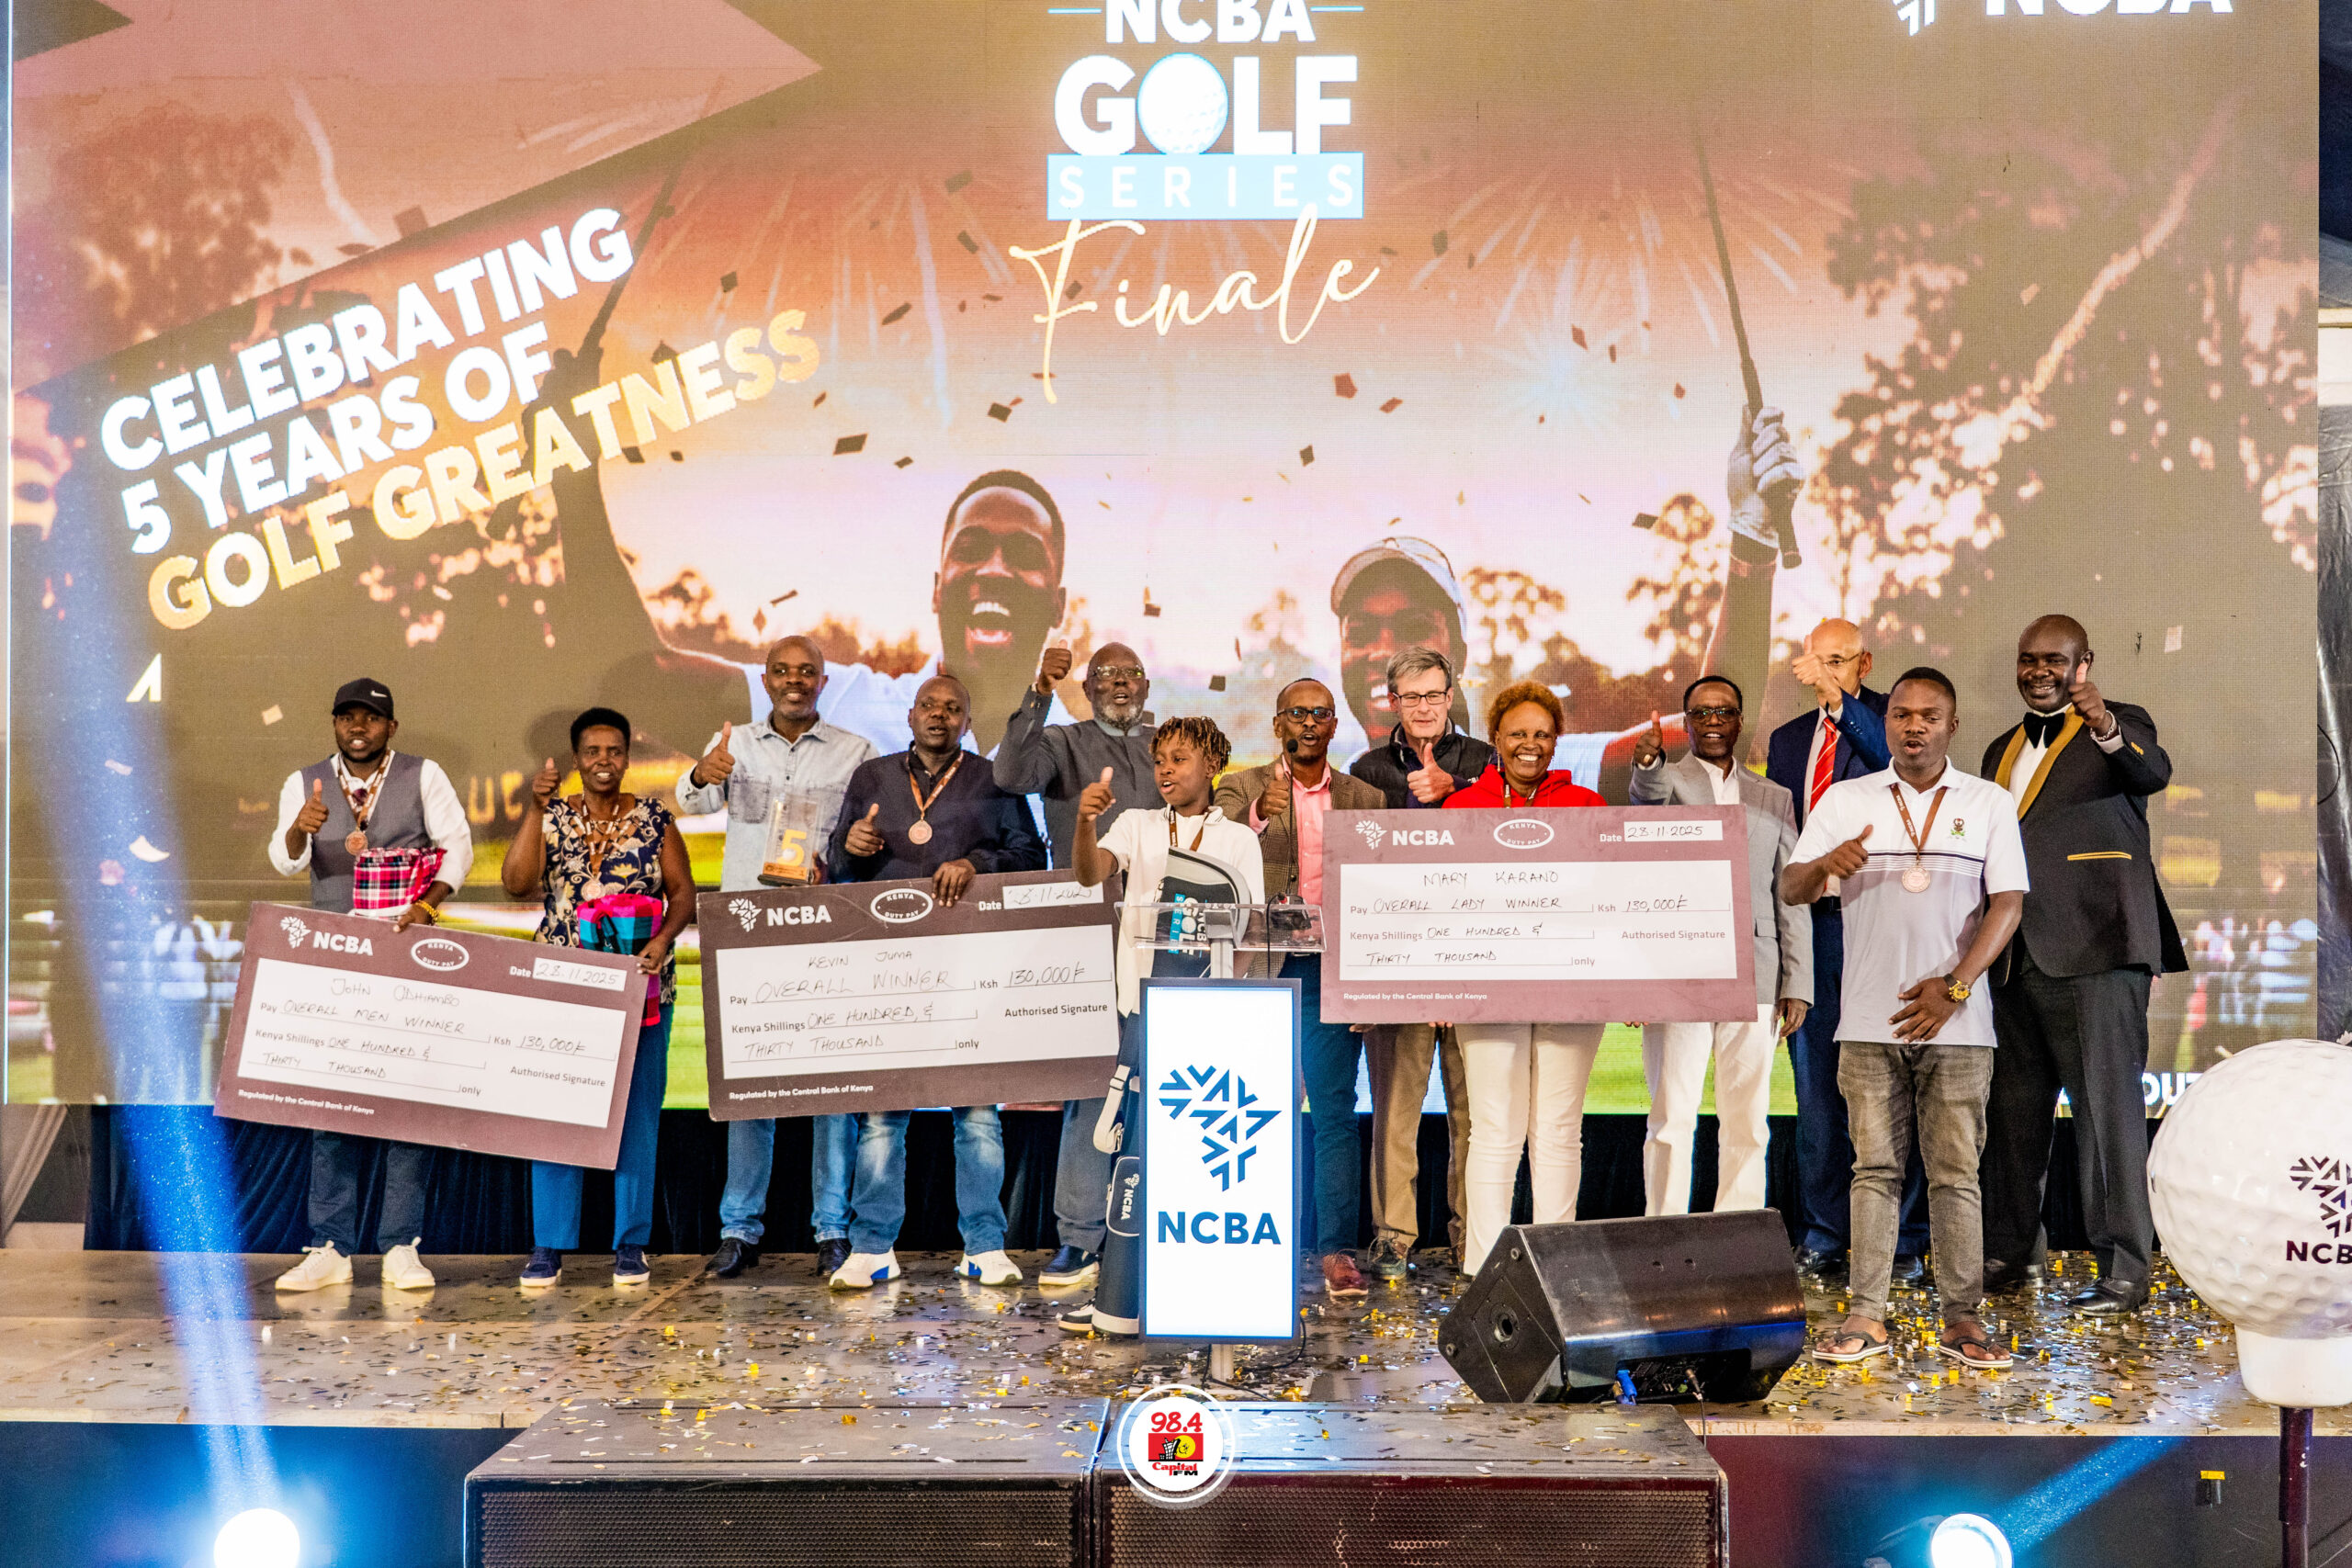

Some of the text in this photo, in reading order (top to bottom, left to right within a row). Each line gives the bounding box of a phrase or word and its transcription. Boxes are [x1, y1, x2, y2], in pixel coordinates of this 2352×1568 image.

[1106, 0, 1317, 43] NCBA
[1054, 52, 1358, 155] GOLF
[1058, 164, 1353, 208] SERIES
[1009, 203, 1380, 404] Finale
[100, 208, 636, 472] CELEBRATING
[120, 321, 552, 555] 5 YEARS OF
[147, 307, 822, 631] GOLF GREATNESS
[1392, 829, 1455, 846] NCBA
[1600, 833, 1623, 842] Date
[1424, 872, 1467, 888] MARY
[887, 893, 914, 901] KENYA
[978, 900, 1001, 911] Date
[1373, 897, 1562, 913] OVERALL LADY WINNER
[766, 904, 832, 927] NCBA
[1351, 906, 1367, 916] Pay
[1598, 903, 1616, 912] Ksh
[1196, 912, 1207, 947] NCB
[1350, 931, 1423, 942] Kenya Shillings
[1427, 927, 1451, 939] ONE
[1465, 926, 1521, 938] HUNDRED
[1622, 930, 1725, 941] Authorised Signature
[313, 931, 374, 956] NCBA
[808, 951, 912, 969] KEVIN JUMA
[1366, 950, 1498, 966] THIRTY THOUSAND
[1574, 956, 1595, 967] only
[509, 965, 532, 978] Date
[755, 969, 954, 1003] OVERALL WINNER
[979, 979, 998, 989] Ksh
[393, 984, 460, 1008] ODHIAMBO
[730, 995, 748, 1006] Pay
[1343, 992, 1487, 1001] Regulated by the Central Bank of Kenya
[260, 1001, 277, 1014] Pay
[1004, 1003, 1108, 1018] Authorised Signature
[284, 999, 465, 1034] OVERALL MEN WINNER
[808, 1012, 836, 1028] ONE
[732, 1021, 806, 1034] Kenya Shillings
[255, 1029, 324, 1047] Kenya Shillings
[494, 1036, 512, 1047] Ksh
[958, 1039, 979, 1050] only
[328, 1037, 351, 1049] ONE
[361, 1040, 416, 1057] HUNDRED
[744, 1034, 885, 1060] THIRTY THOUSAND
[263, 1052, 388, 1079] THIRTY THOUSAND
[510, 1065, 606, 1088] Authorised Signature
[461, 1084, 481, 1097] only
[729, 1084, 874, 1101] Regulated by the Central Bank of Kenya
[2141, 1072, 2204, 1106] OU
[238, 1089, 375, 1116] Regulated by the Central Bank of Kenya
[1121, 1189, 1135, 1221] NCBA
[1157, 1211, 1282, 1245] NCBA
[2286, 1240, 2352, 1264] NCB
